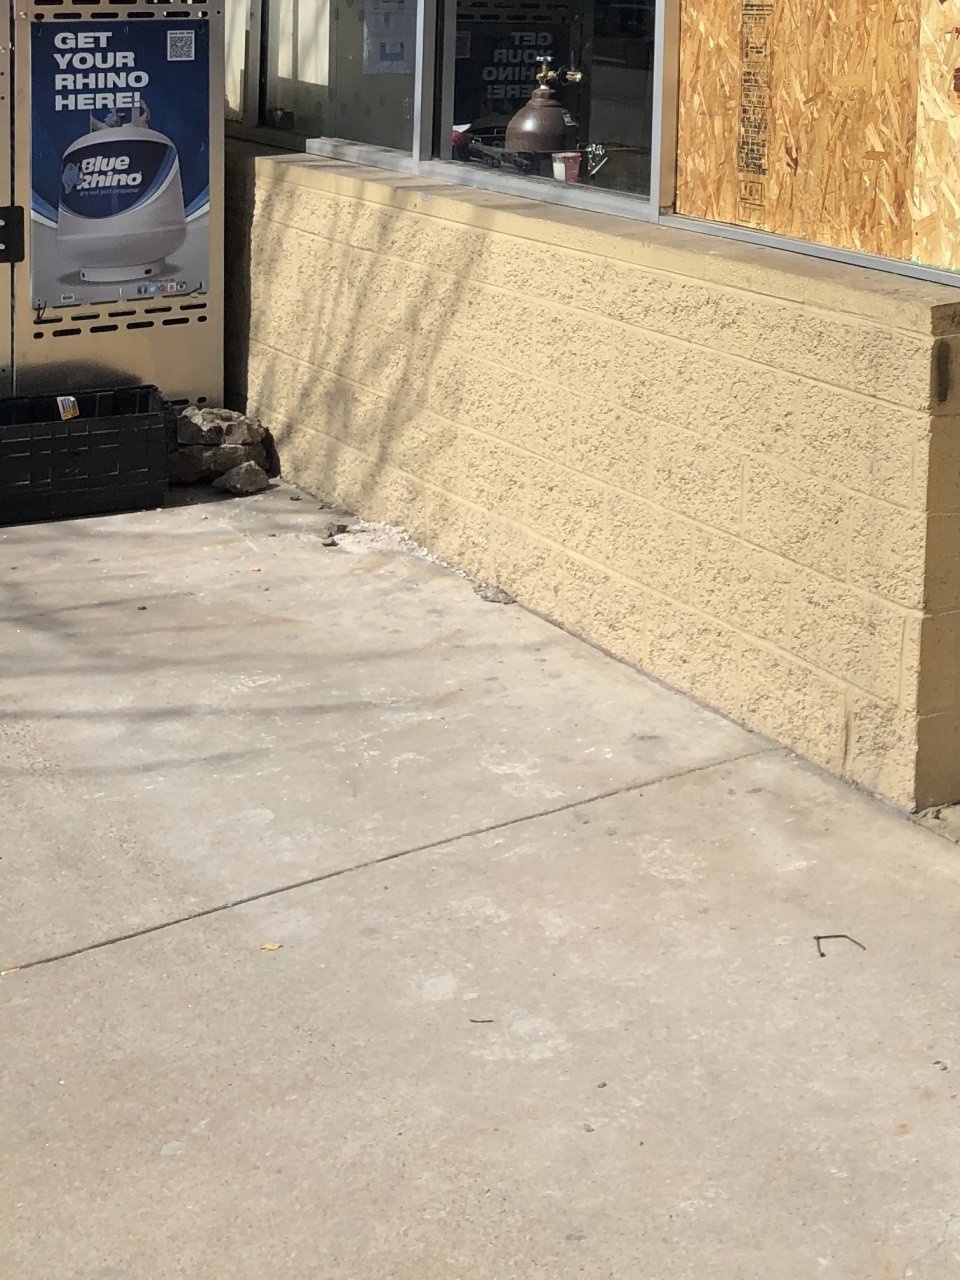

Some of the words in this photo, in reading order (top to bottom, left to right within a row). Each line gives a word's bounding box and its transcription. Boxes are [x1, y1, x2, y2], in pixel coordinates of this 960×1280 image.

[54, 31, 112, 49] GET
[53, 51, 135, 70] YOUR
[55, 71, 149, 90] RHINO
[55, 92, 141, 111] HERE!
[81, 155, 130, 173] Blue
[76, 171, 142, 190] Rhino
